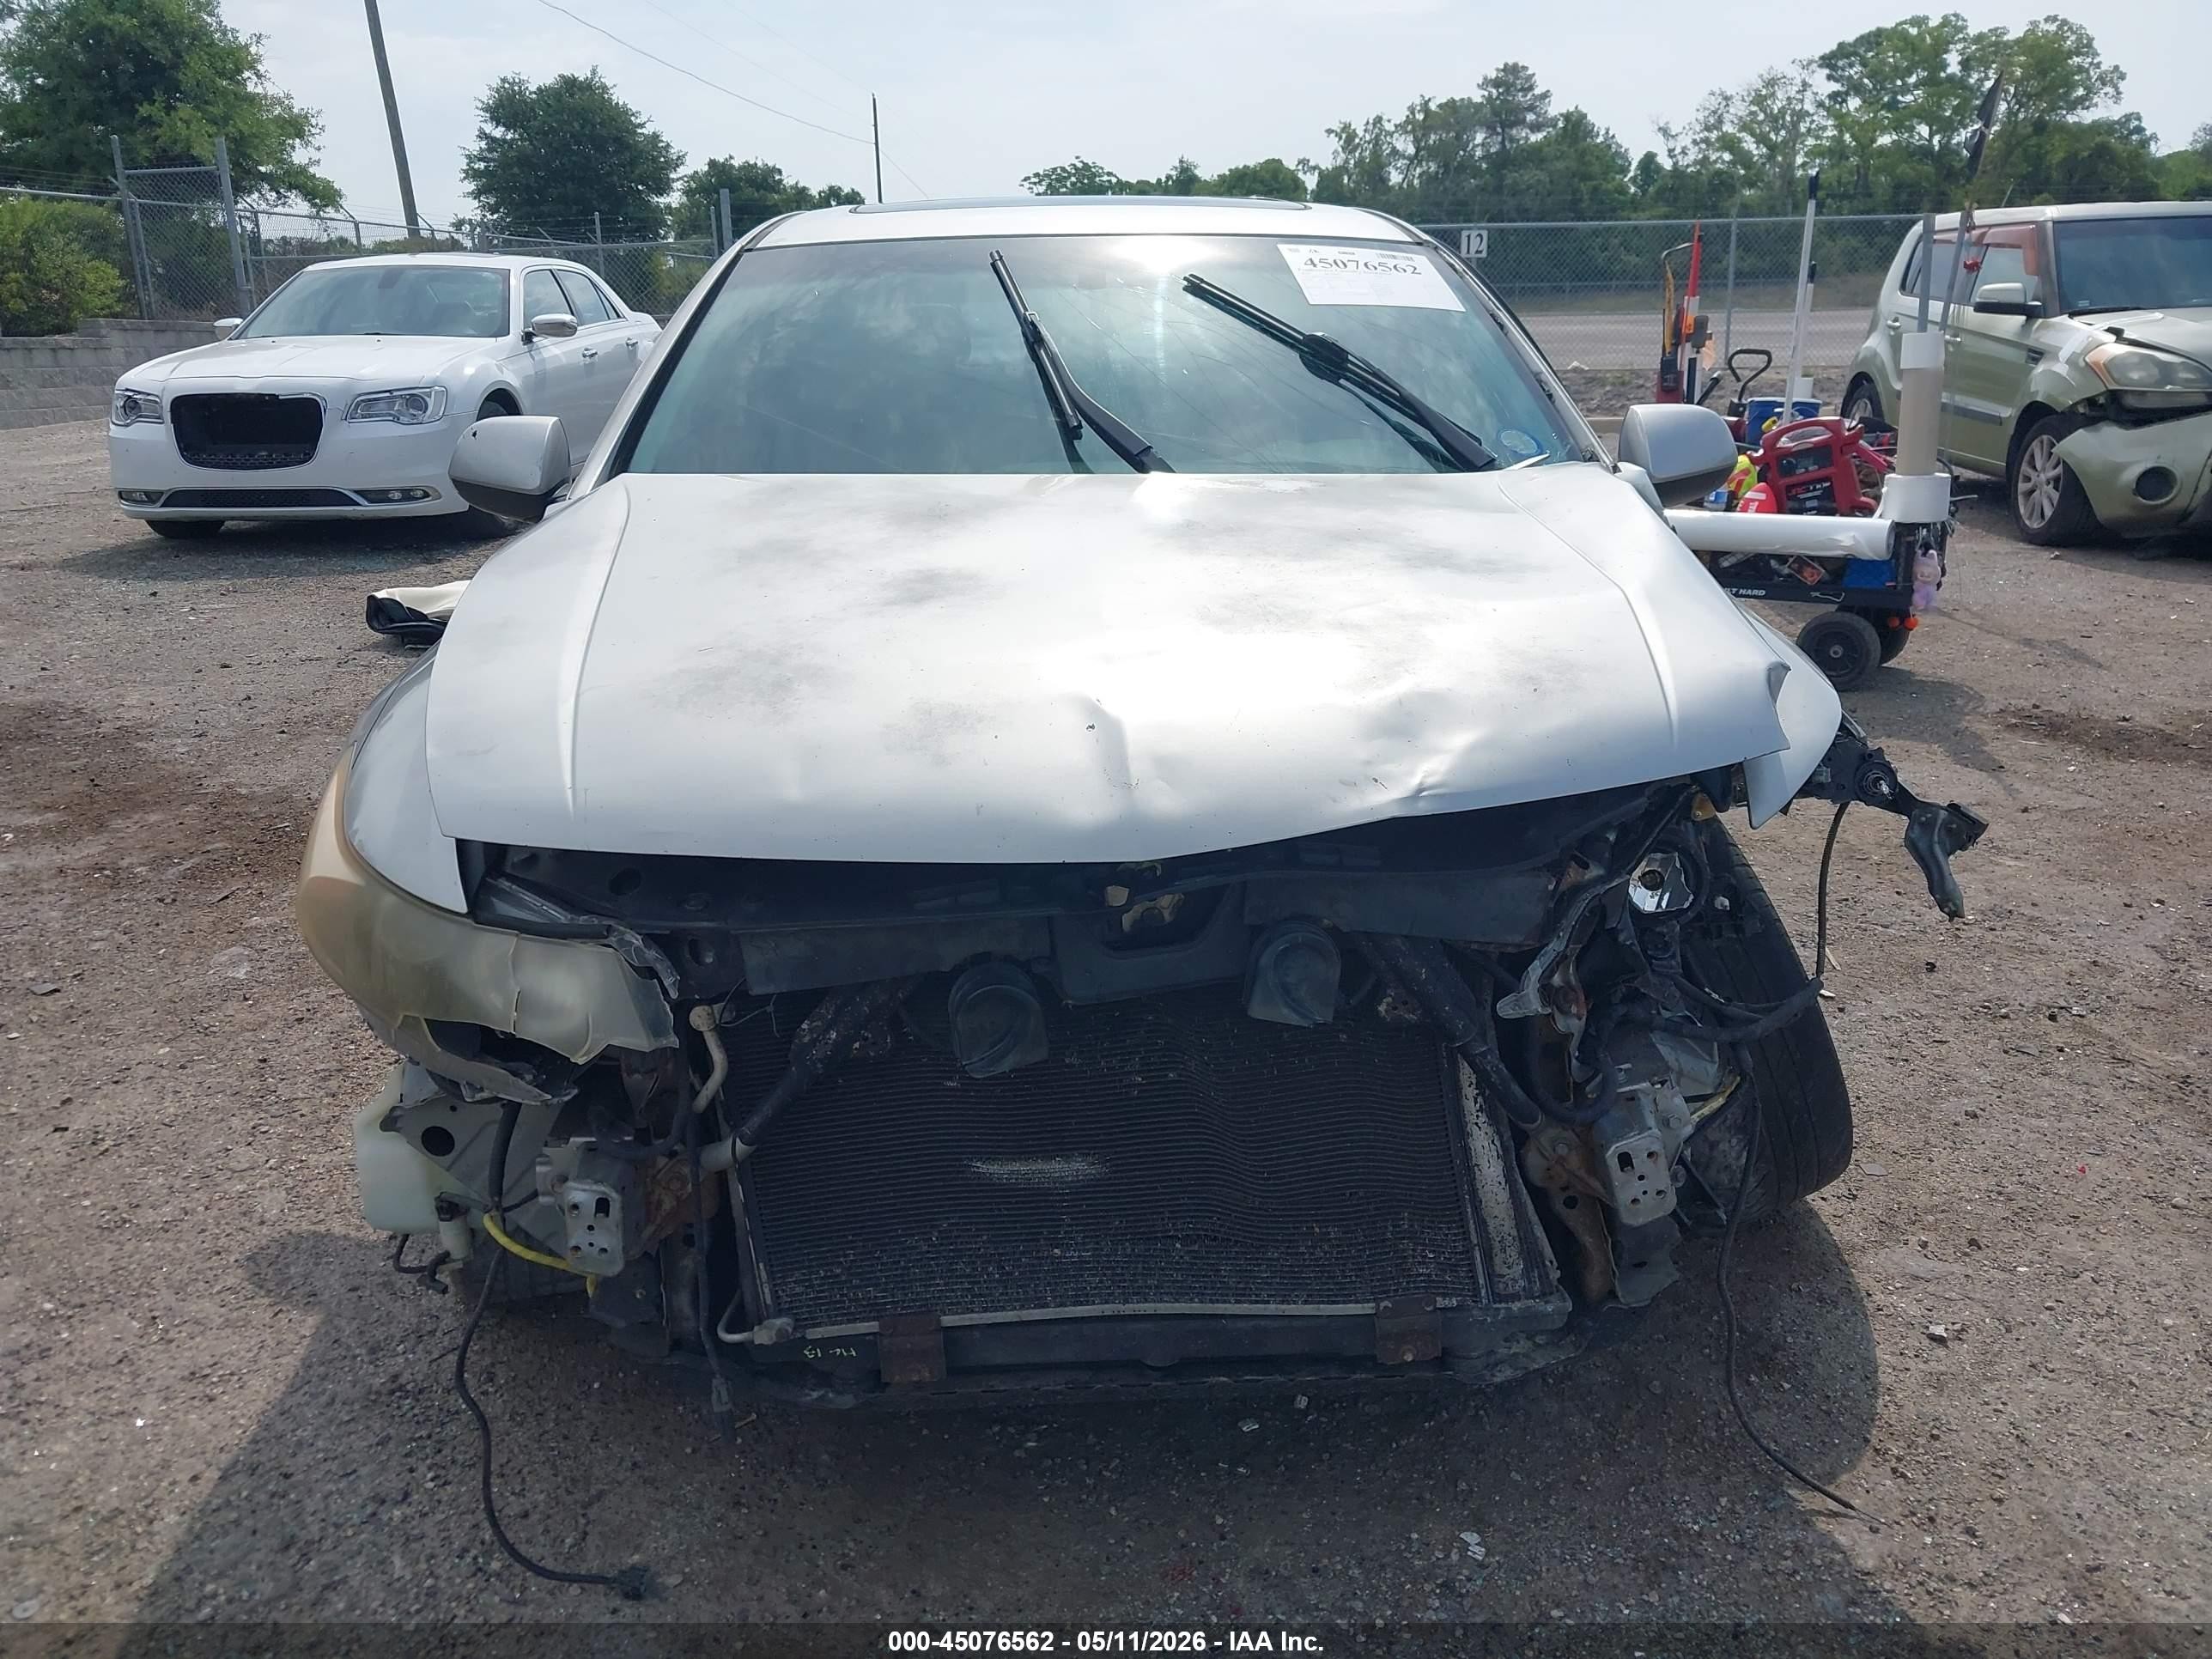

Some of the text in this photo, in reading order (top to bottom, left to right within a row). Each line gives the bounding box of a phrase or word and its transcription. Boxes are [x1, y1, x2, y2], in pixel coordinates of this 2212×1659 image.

[1465, 233, 1484, 255] 12
[1304, 257, 1422, 276] 45076562
[1739, 588, 1765, 597] HARD
